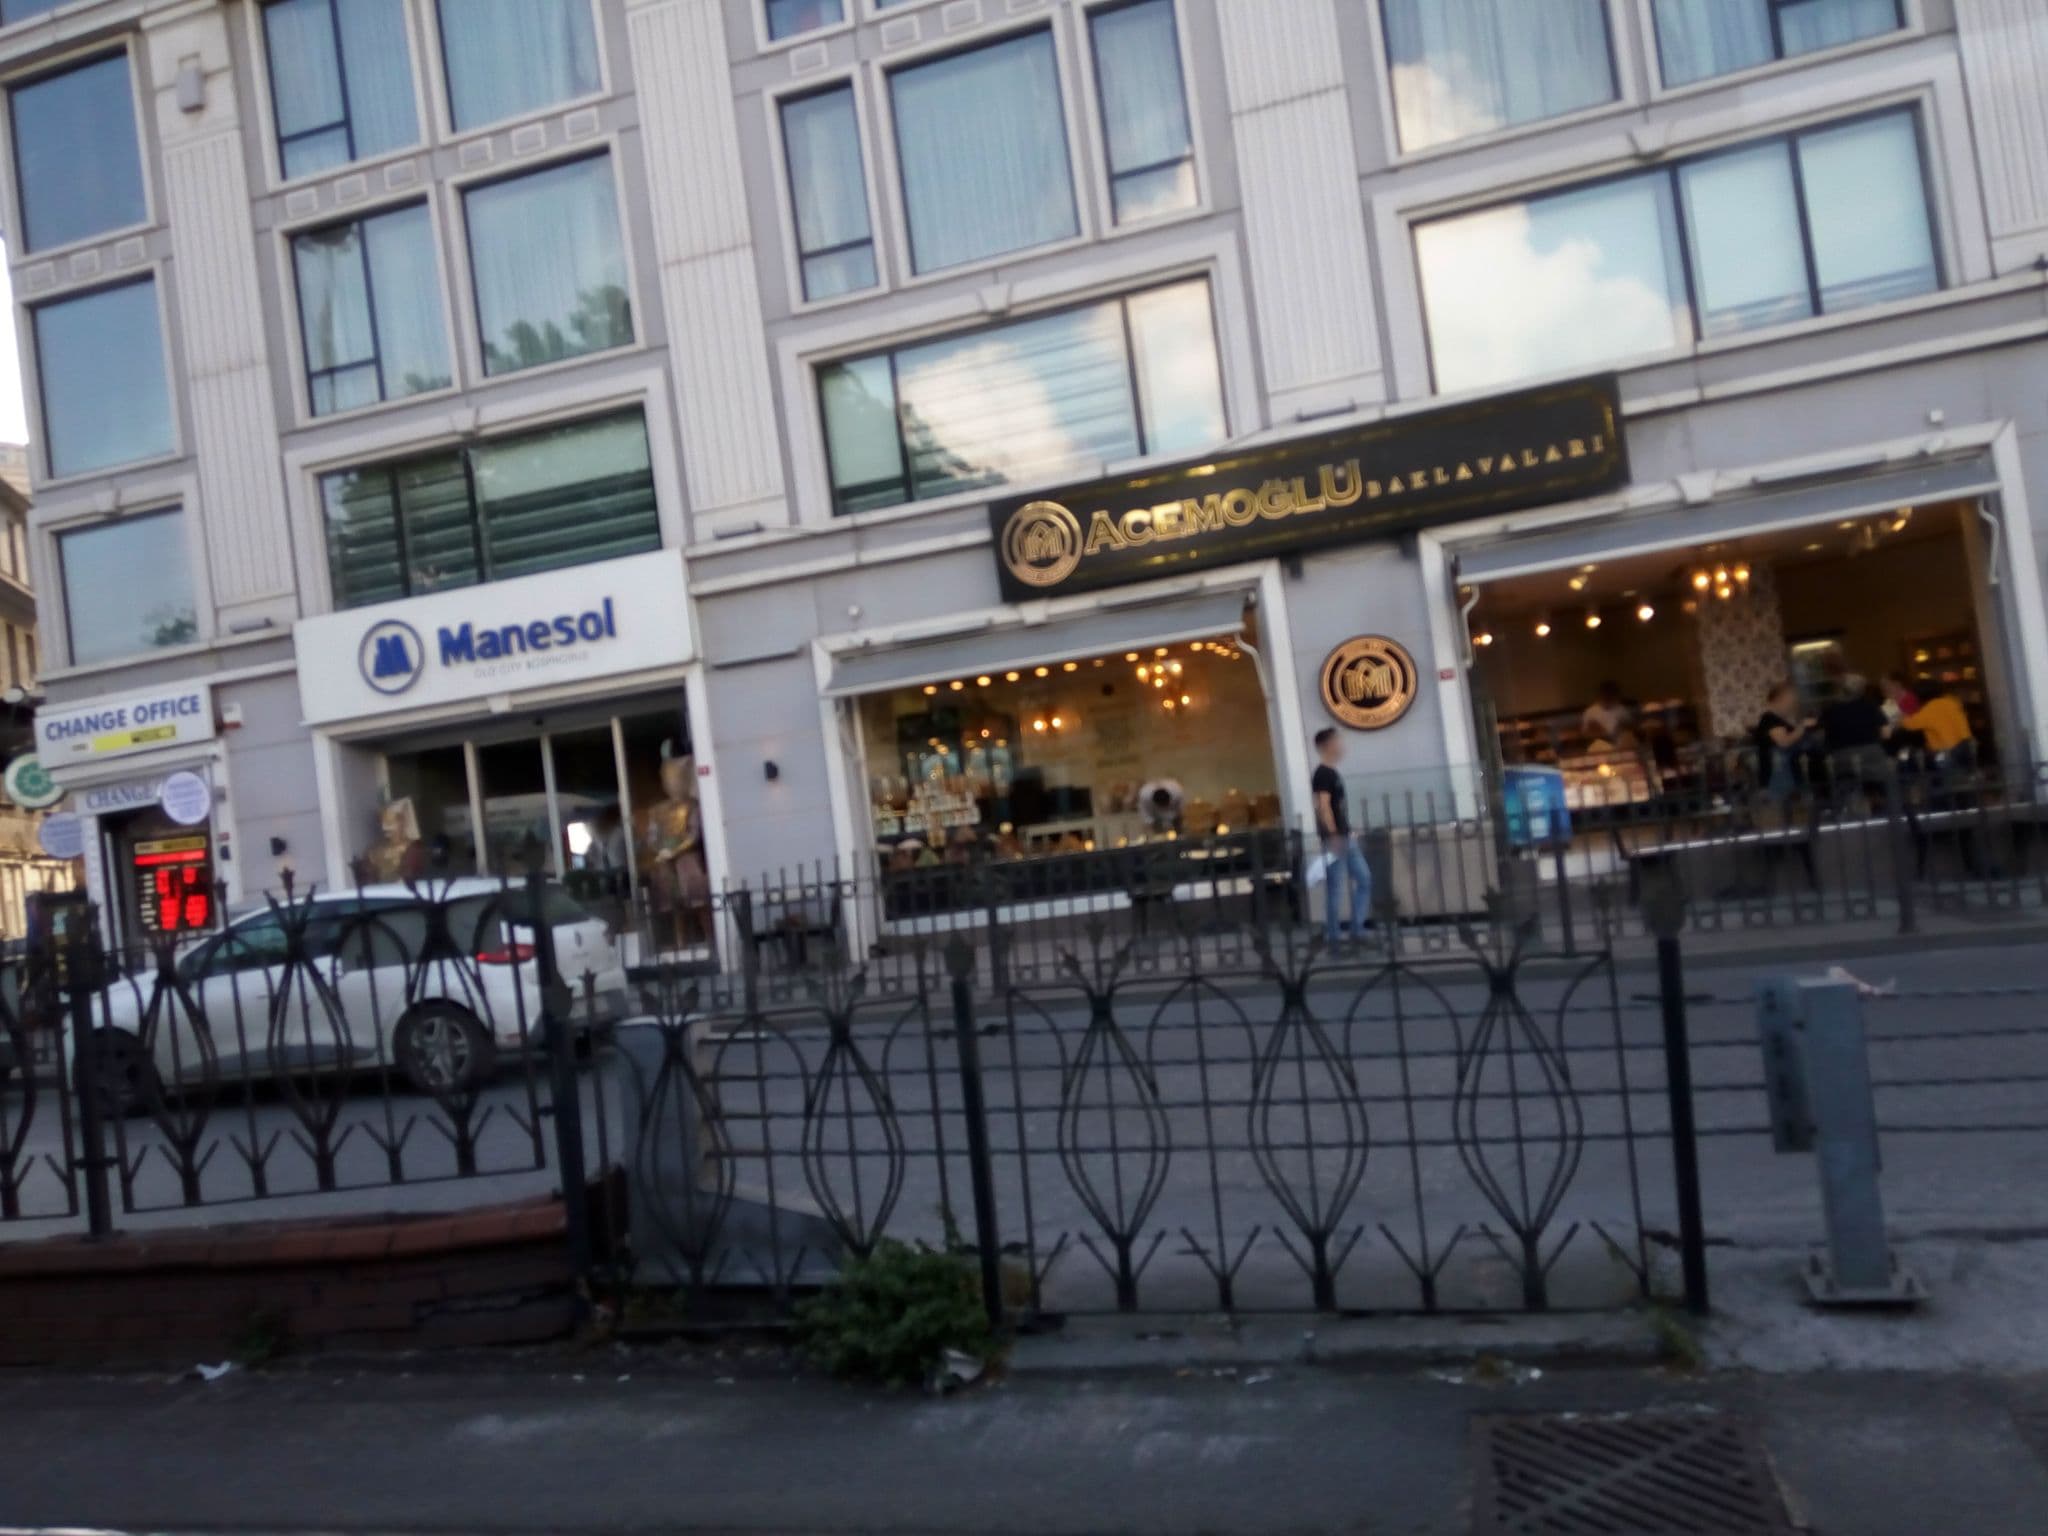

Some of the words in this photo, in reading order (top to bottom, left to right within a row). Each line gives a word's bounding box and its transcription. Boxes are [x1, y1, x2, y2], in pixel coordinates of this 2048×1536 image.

[436, 597, 617, 667] Manesol
[45, 709, 128, 741] CHANGE
[133, 694, 201, 725] OFFICE
[86, 783, 154, 810] CHANGE
